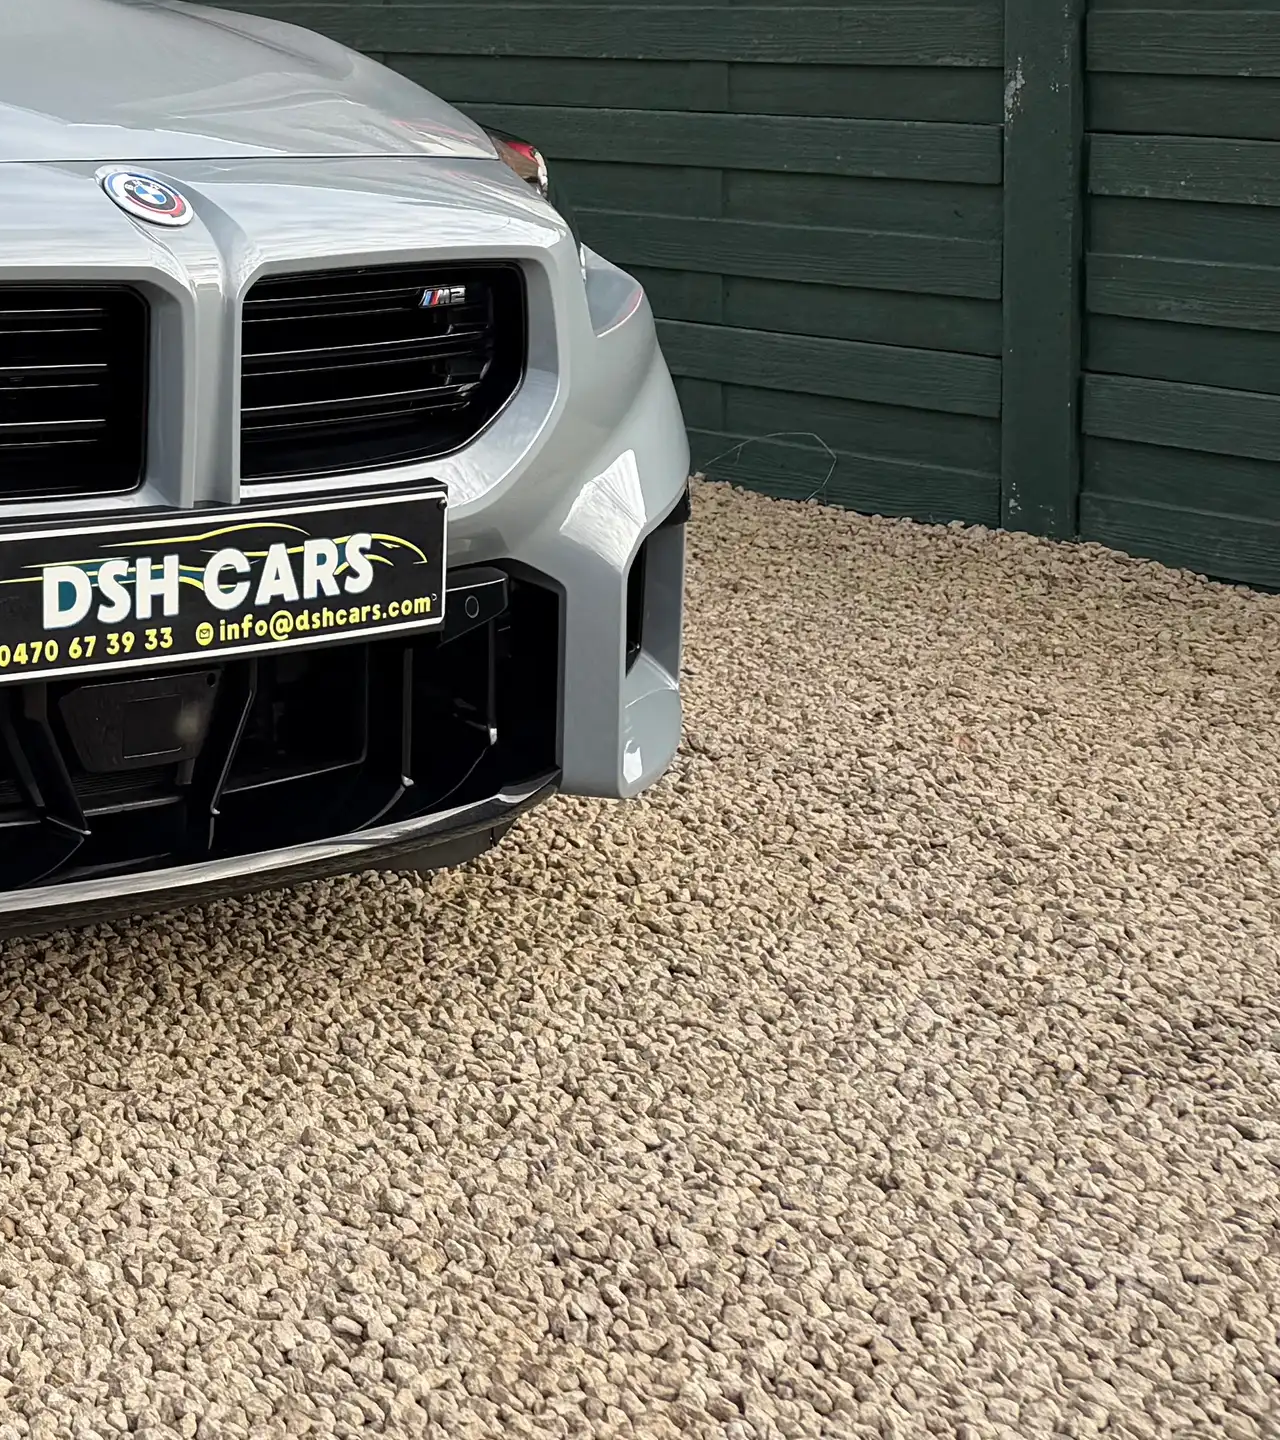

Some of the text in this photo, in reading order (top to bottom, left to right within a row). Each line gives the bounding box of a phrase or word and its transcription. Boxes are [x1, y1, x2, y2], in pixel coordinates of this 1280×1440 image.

[42, 533, 374, 630] DSH CARS
[219, 594, 431, 642] info@dshcars.com
[68, 635, 97, 659] 67
[106, 631, 135, 655] 39
[144, 627, 173, 650] 33
